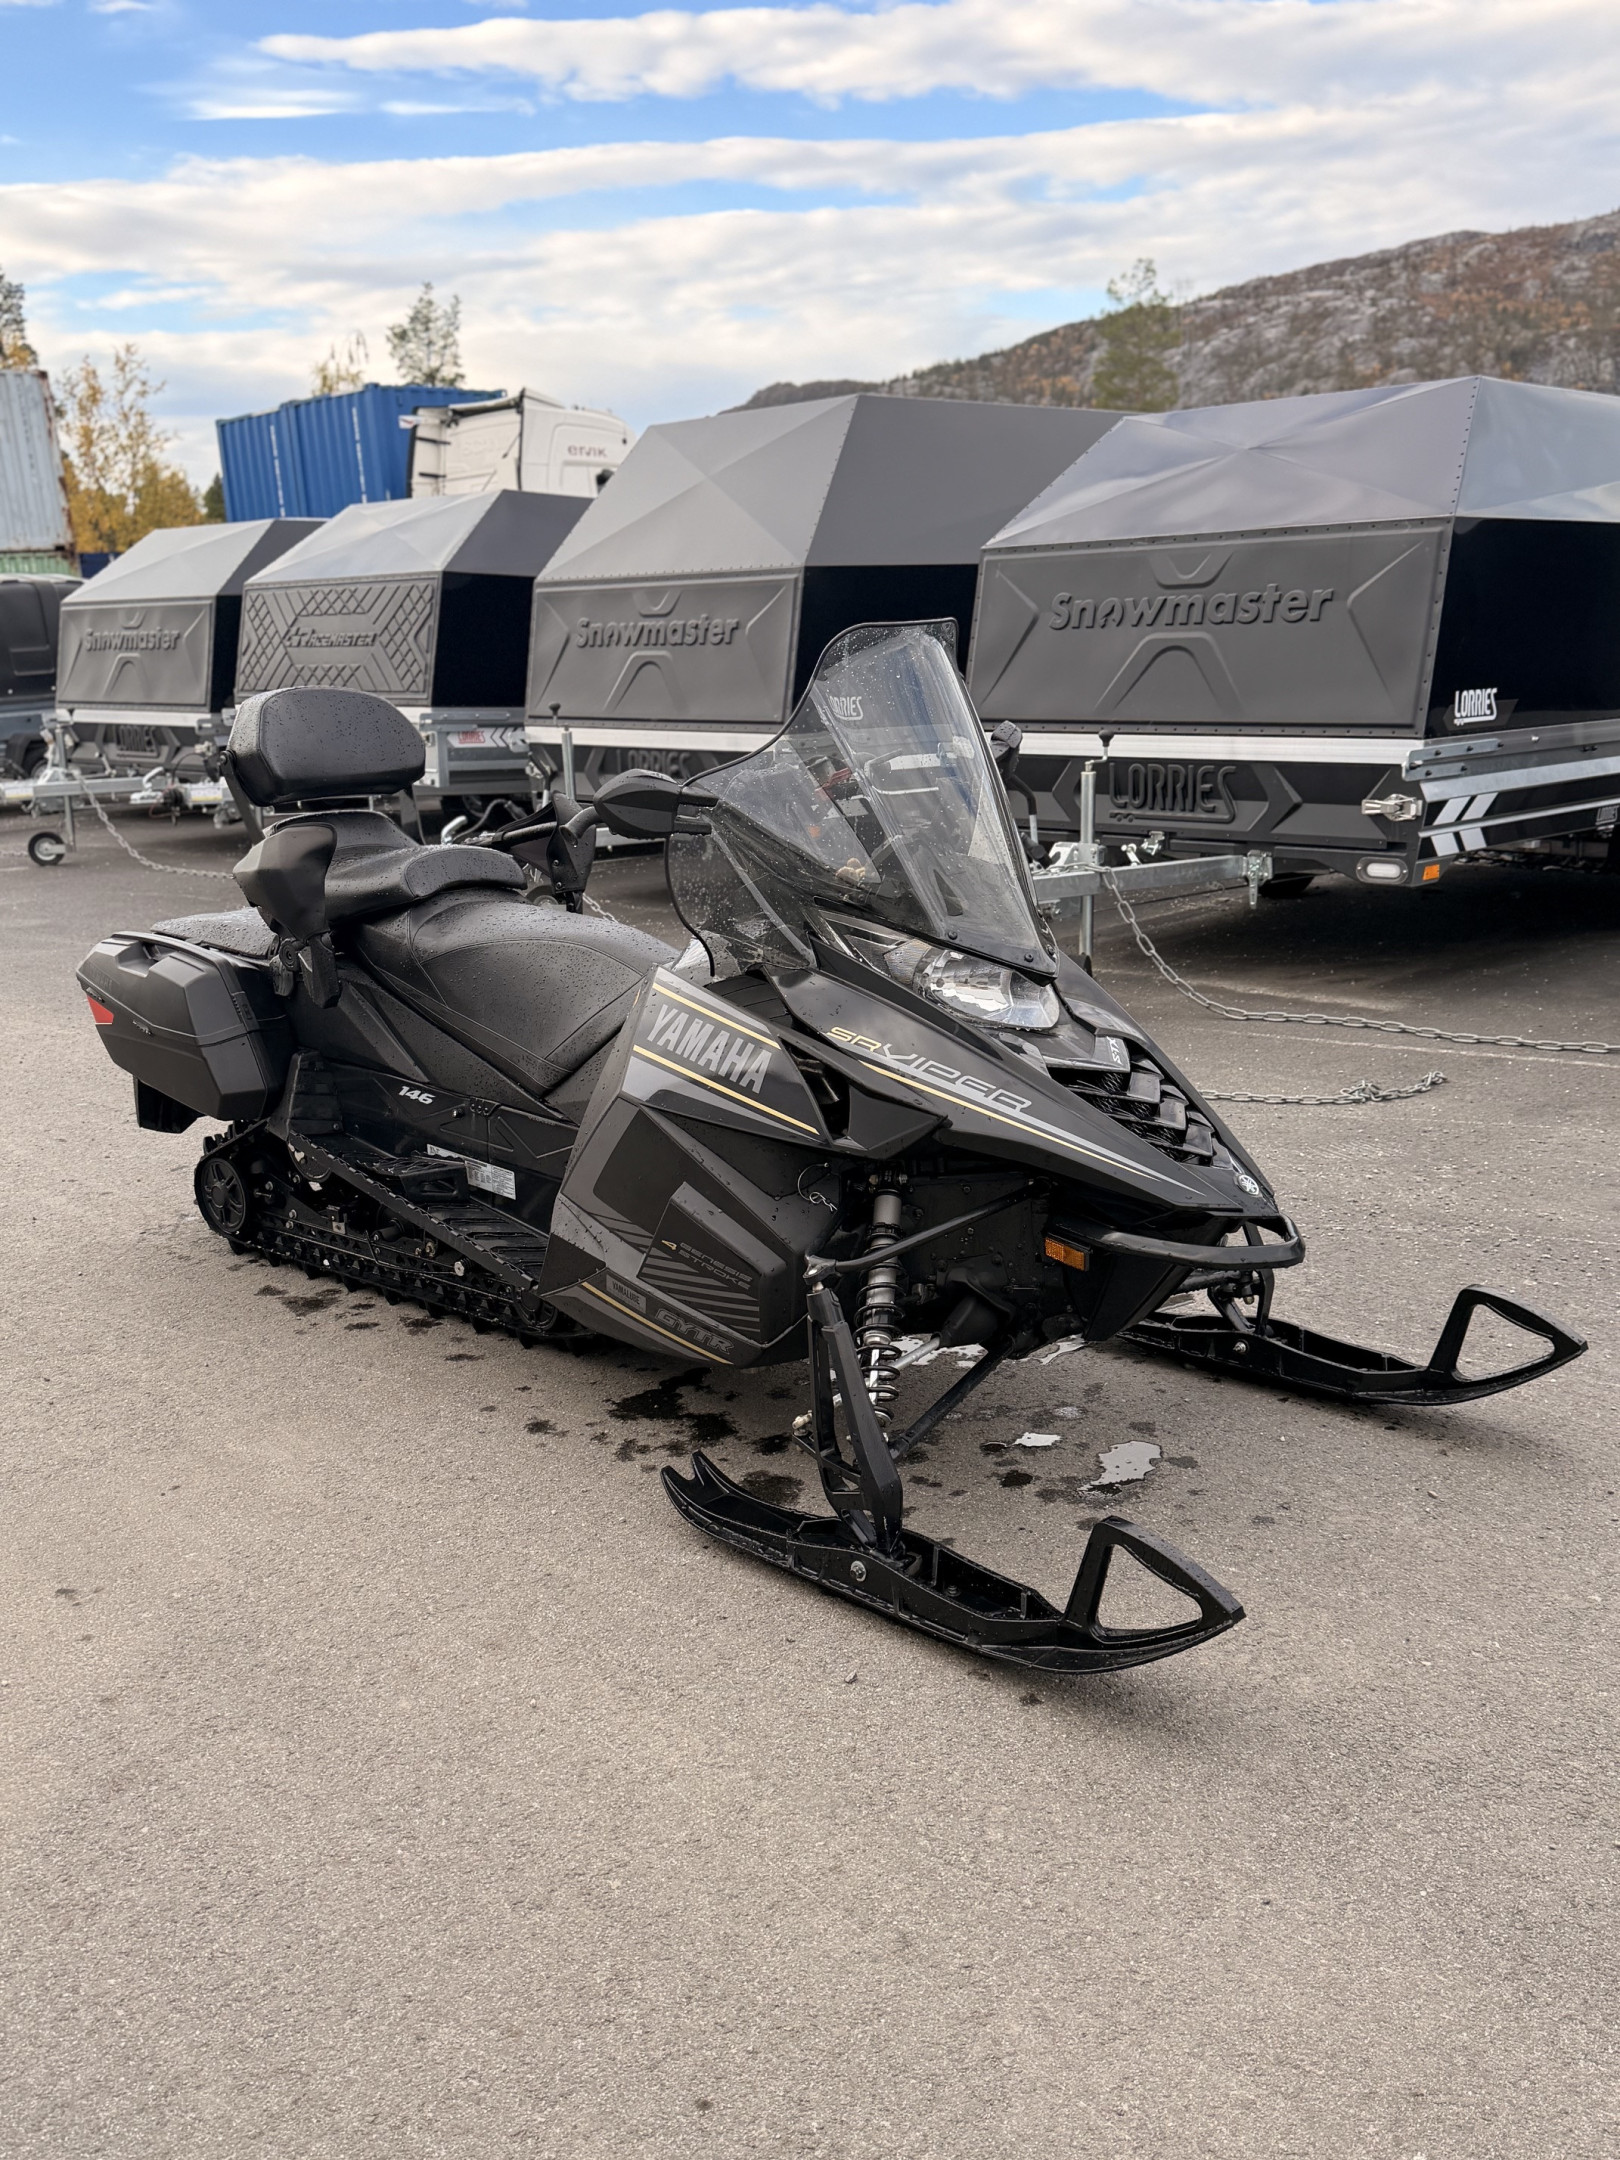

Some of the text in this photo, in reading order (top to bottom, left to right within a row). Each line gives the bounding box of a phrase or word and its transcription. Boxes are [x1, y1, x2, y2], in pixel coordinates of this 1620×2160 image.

[1049, 583, 1335, 630] Snowmaster
[576, 614, 739, 648] Snowmaster
[1454, 687, 1498, 726] LORRIES
[1109, 762, 1237, 824] LORRIES
[647, 1004, 772, 1094] YAMAHA
[399, 1086, 436, 1104] 146
[678, 1249, 751, 1290] STROKE
[654, 1308, 735, 1355] GYTR
